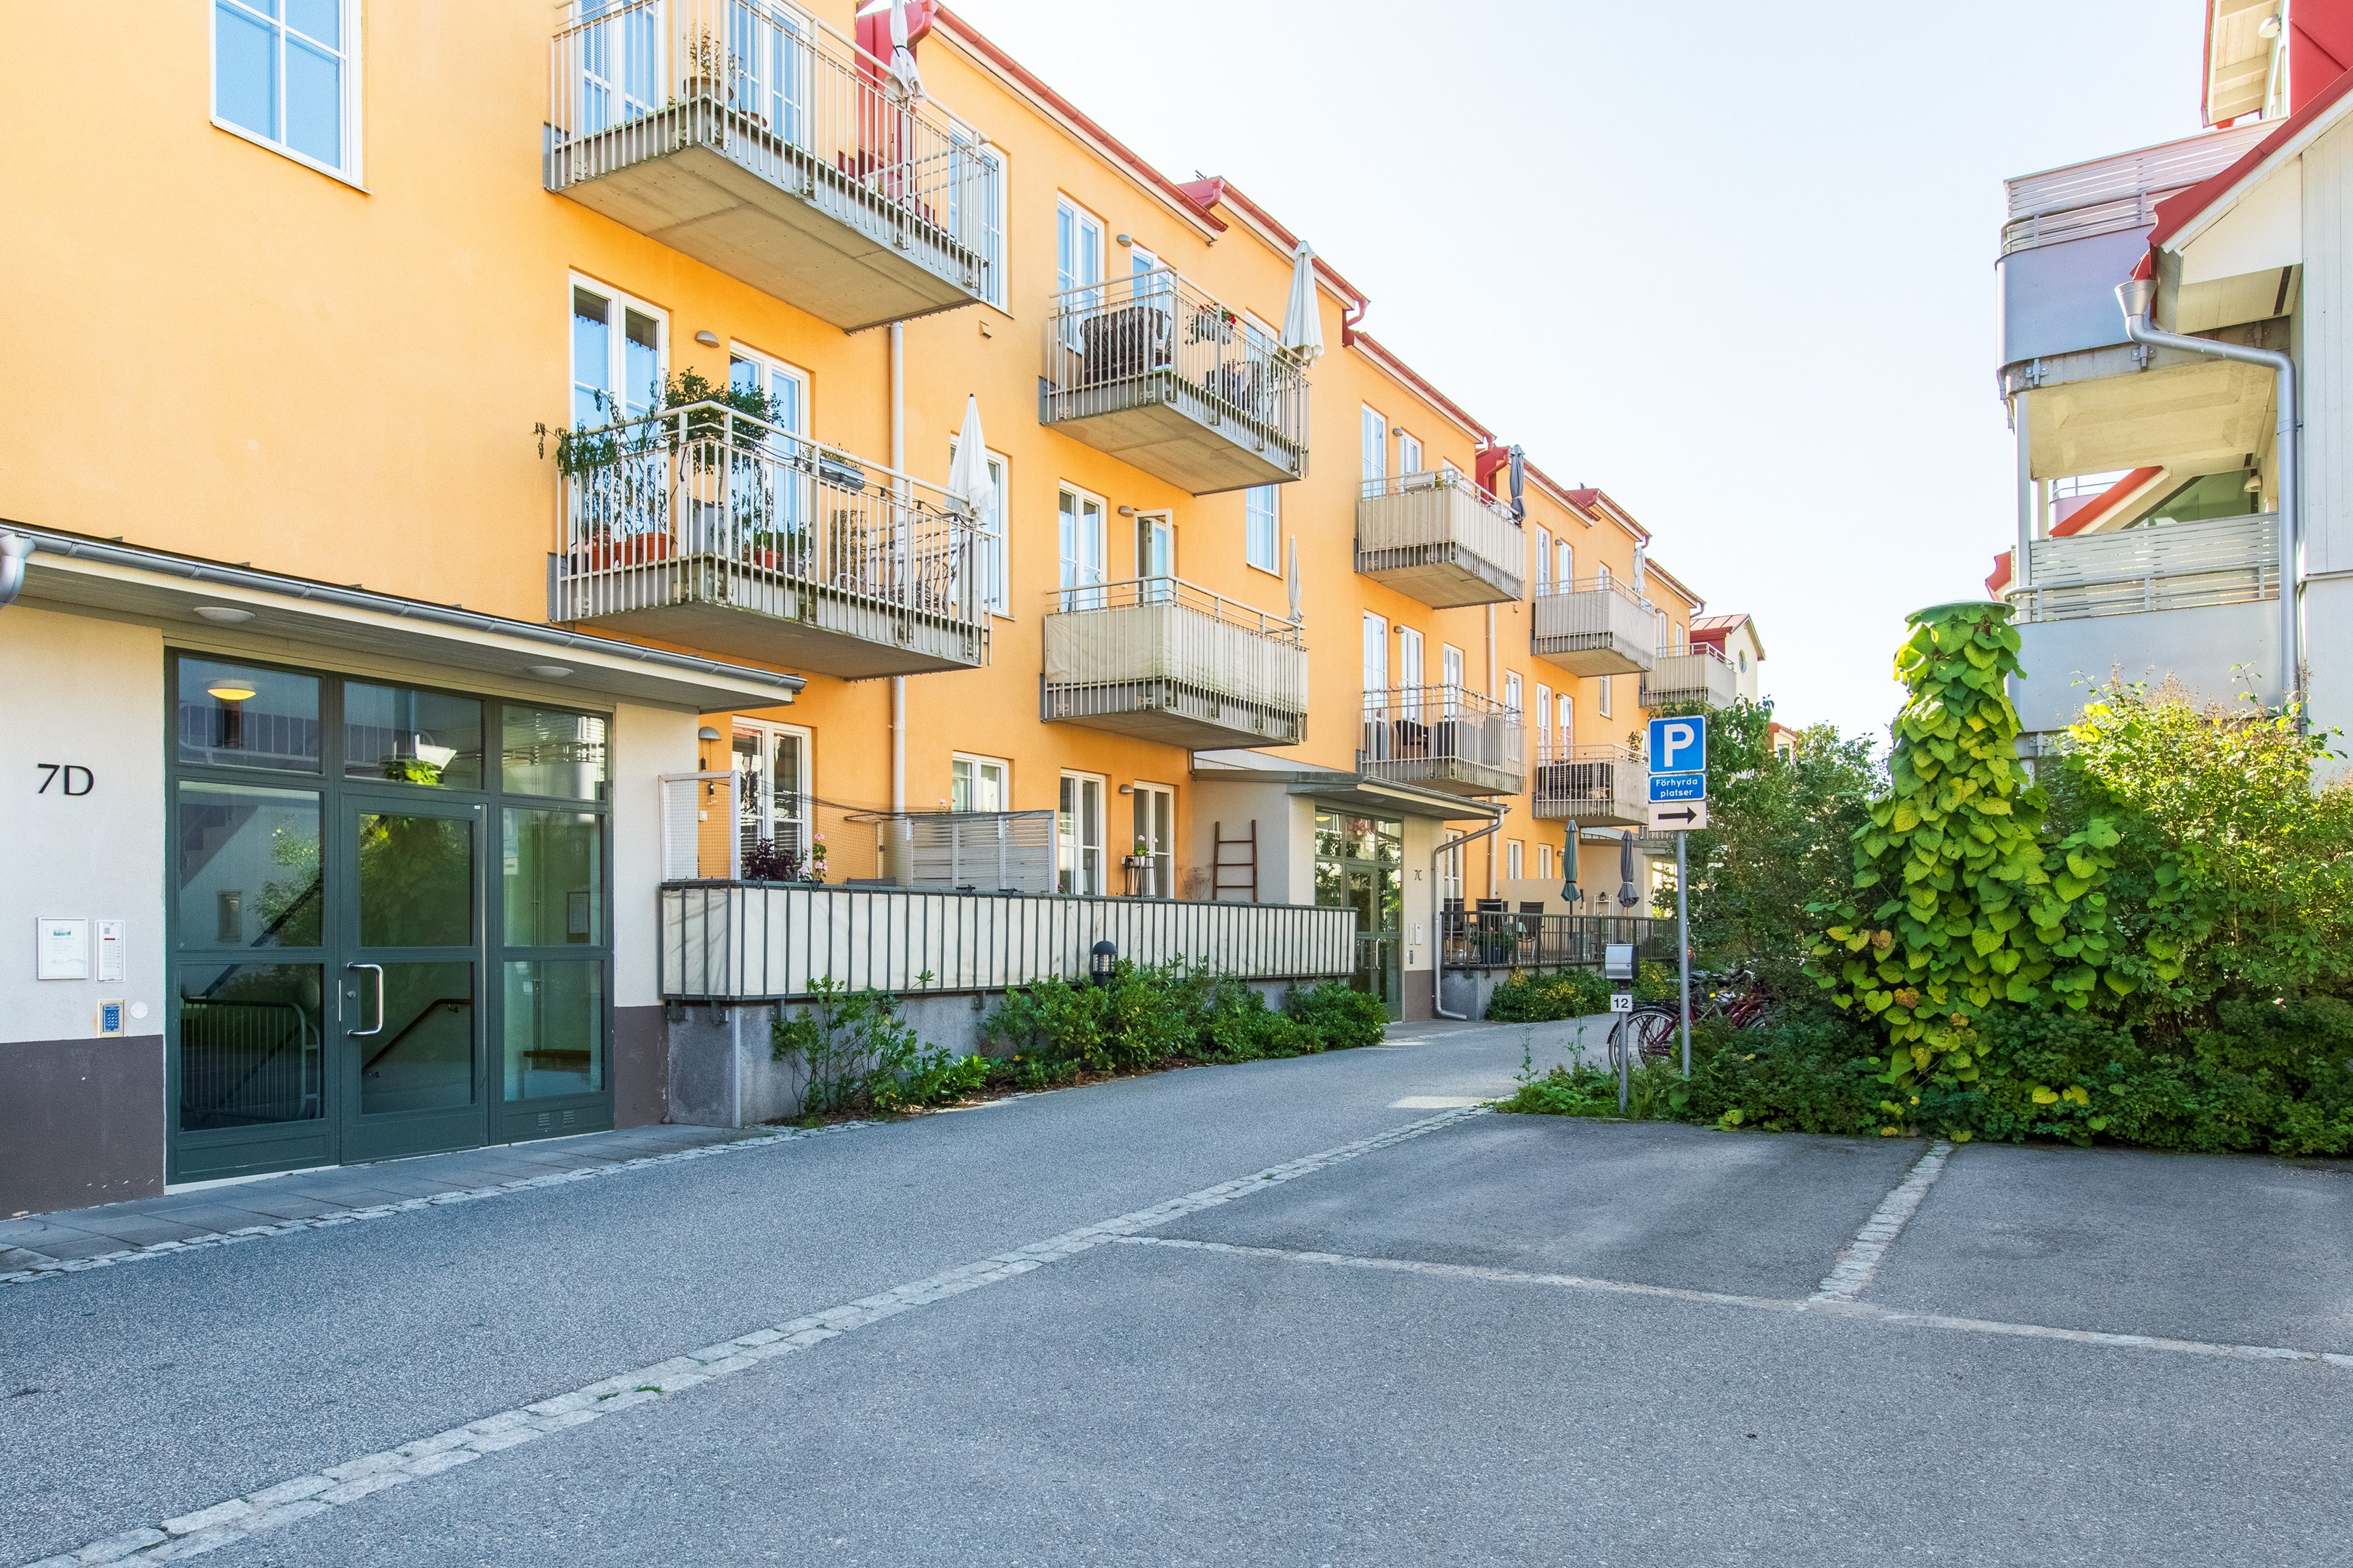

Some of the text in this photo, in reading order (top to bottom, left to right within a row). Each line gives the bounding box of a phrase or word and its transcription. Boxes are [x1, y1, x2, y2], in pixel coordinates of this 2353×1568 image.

[1664, 723, 1695, 767] P
[37, 763, 94, 796] 7D
[1655, 778, 1698, 788] Förhyrda
[1660, 788, 1693, 799] platser
[1613, 997, 1629, 1008] 12
